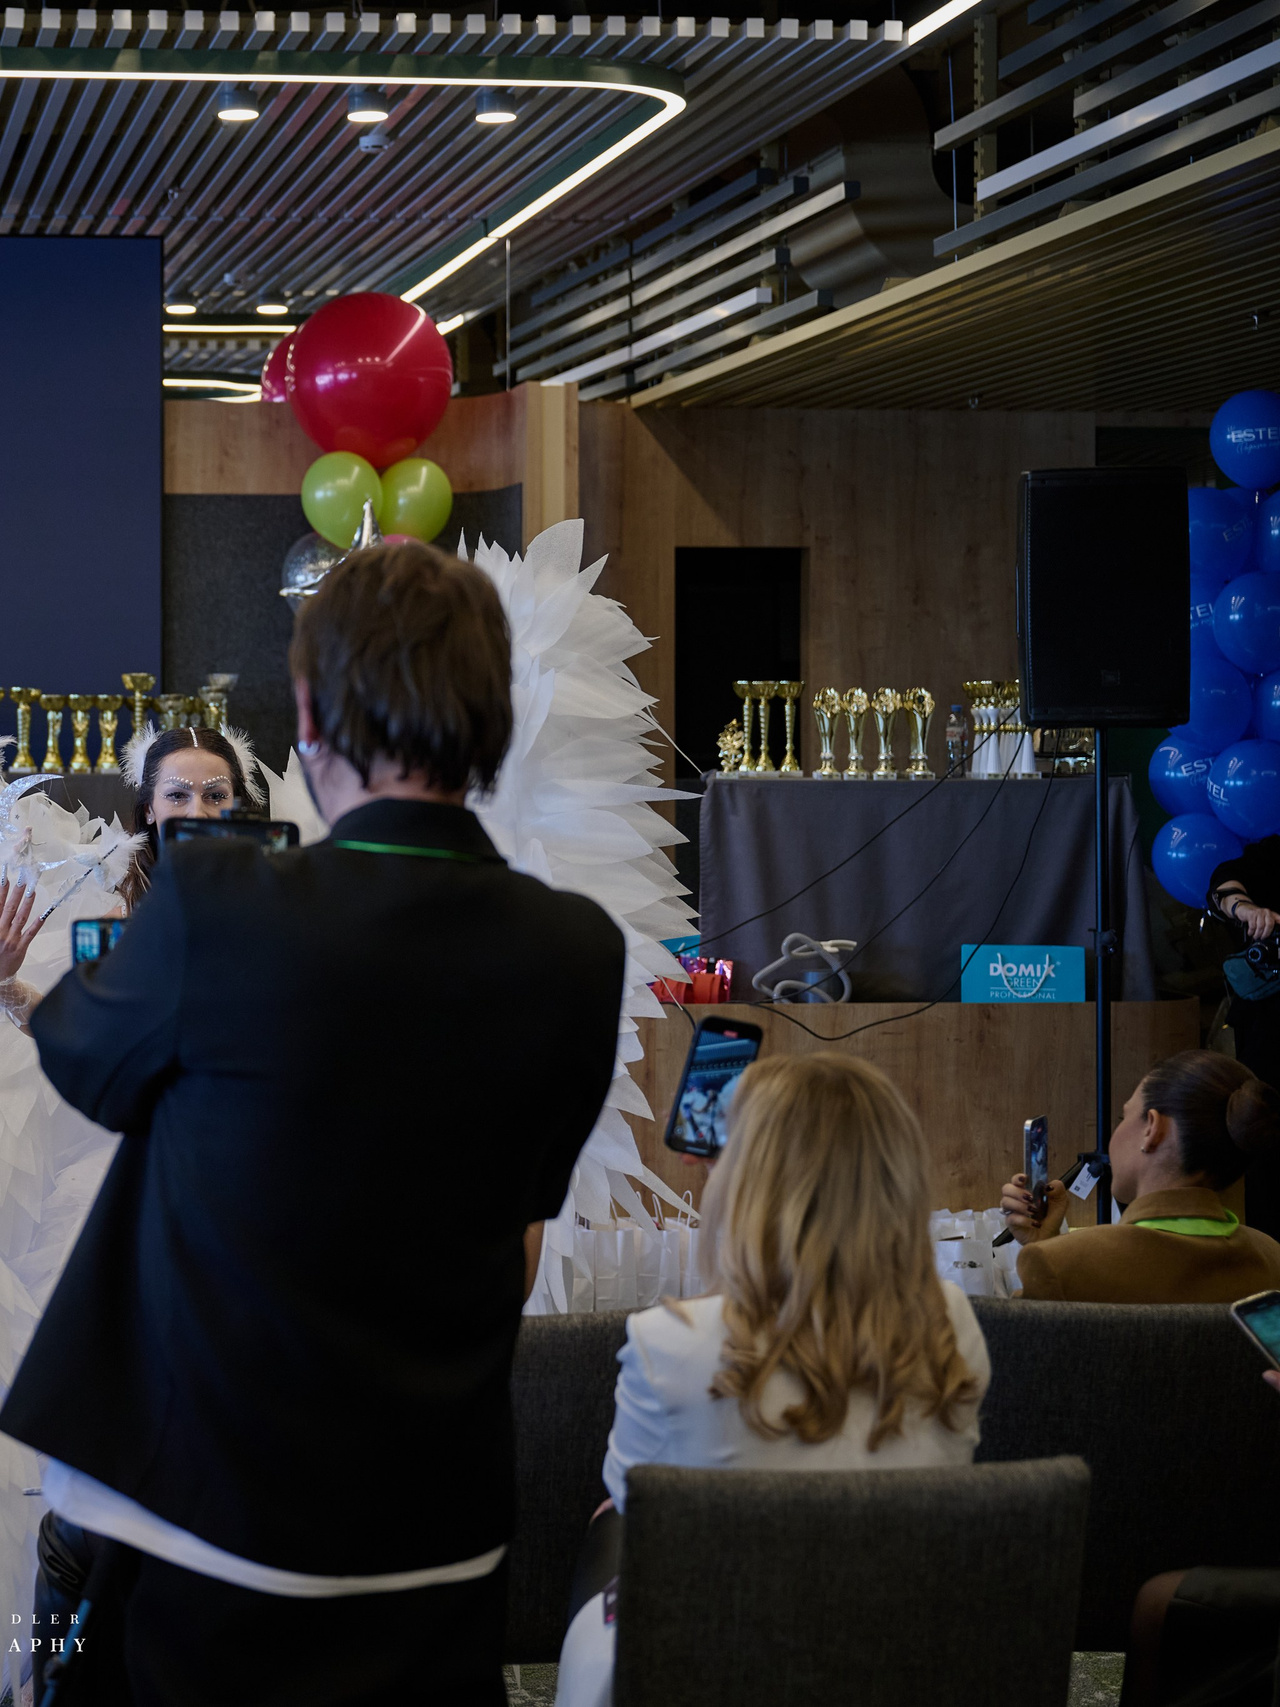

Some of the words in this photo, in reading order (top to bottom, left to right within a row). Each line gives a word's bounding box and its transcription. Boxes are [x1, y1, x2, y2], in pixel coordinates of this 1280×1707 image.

[1231, 427, 1280, 443] ESTE
[1207, 777, 1229, 802] TEL
[989, 962, 1056, 978] DOMIX
[990, 991, 1056, 1000] PROFEONAL
